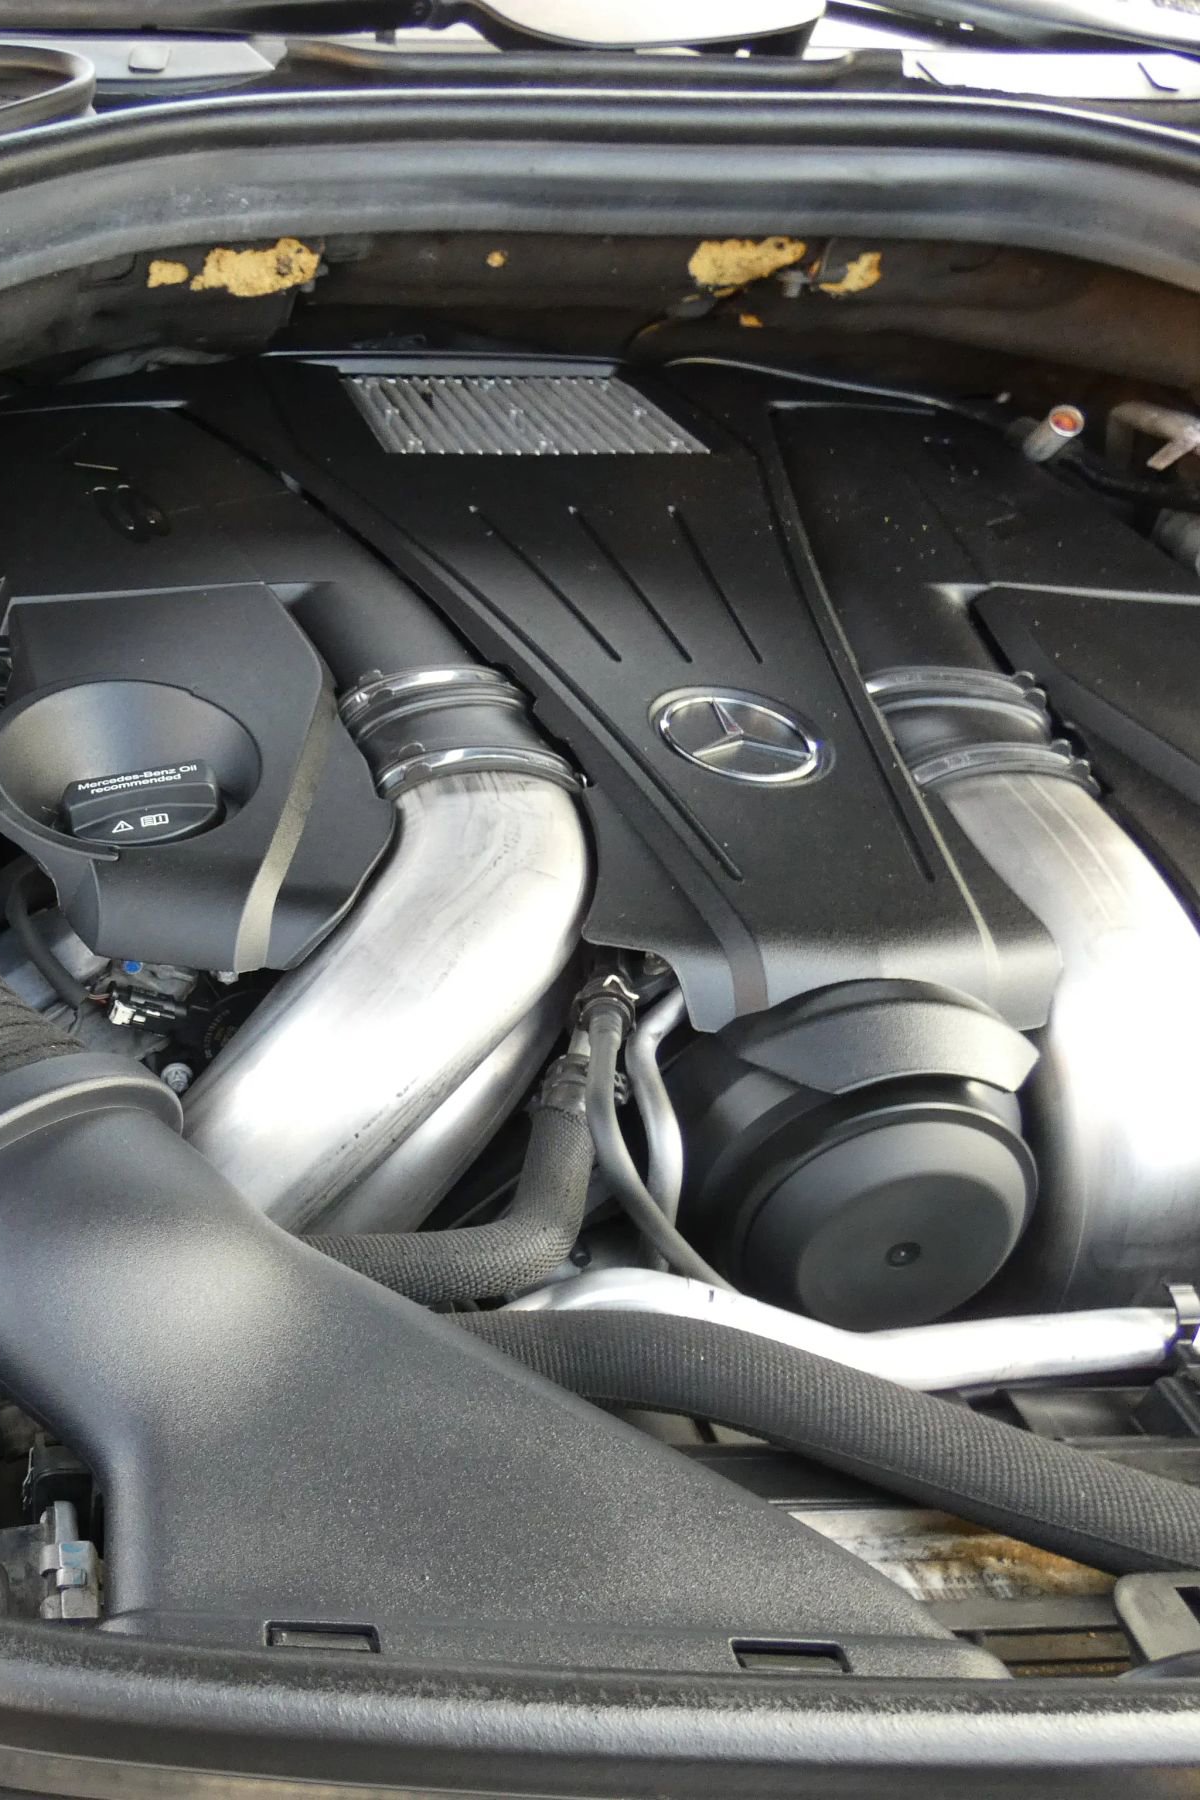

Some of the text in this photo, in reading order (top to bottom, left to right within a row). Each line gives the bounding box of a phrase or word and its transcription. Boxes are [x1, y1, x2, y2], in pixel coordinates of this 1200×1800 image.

[78, 764, 198, 791] Mercedes-Benz Oil
[90, 773, 182, 795] recommended
